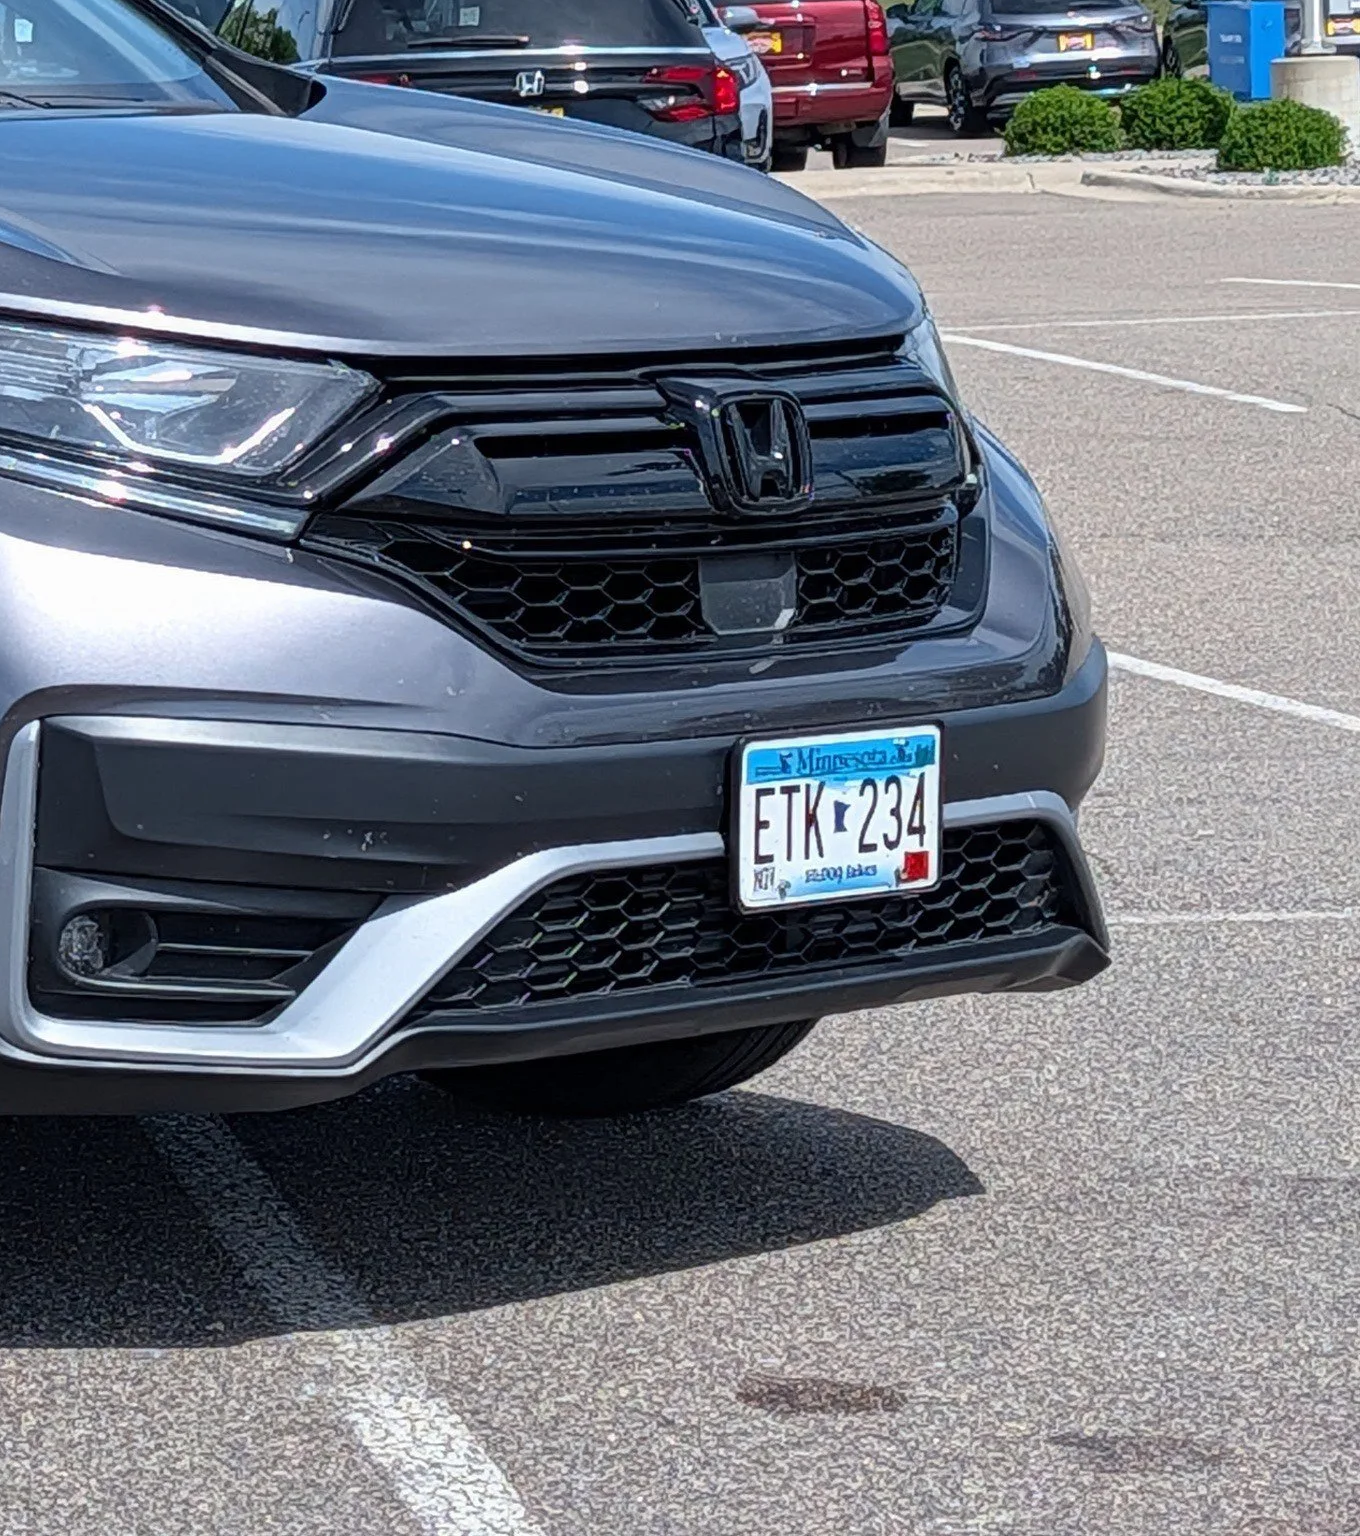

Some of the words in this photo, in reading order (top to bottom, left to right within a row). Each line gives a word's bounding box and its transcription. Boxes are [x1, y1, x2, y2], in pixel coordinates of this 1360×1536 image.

[797, 746, 887, 774] Minnesota
[753, 780, 826, 865] ETK
[858, 771, 927, 854] 234
